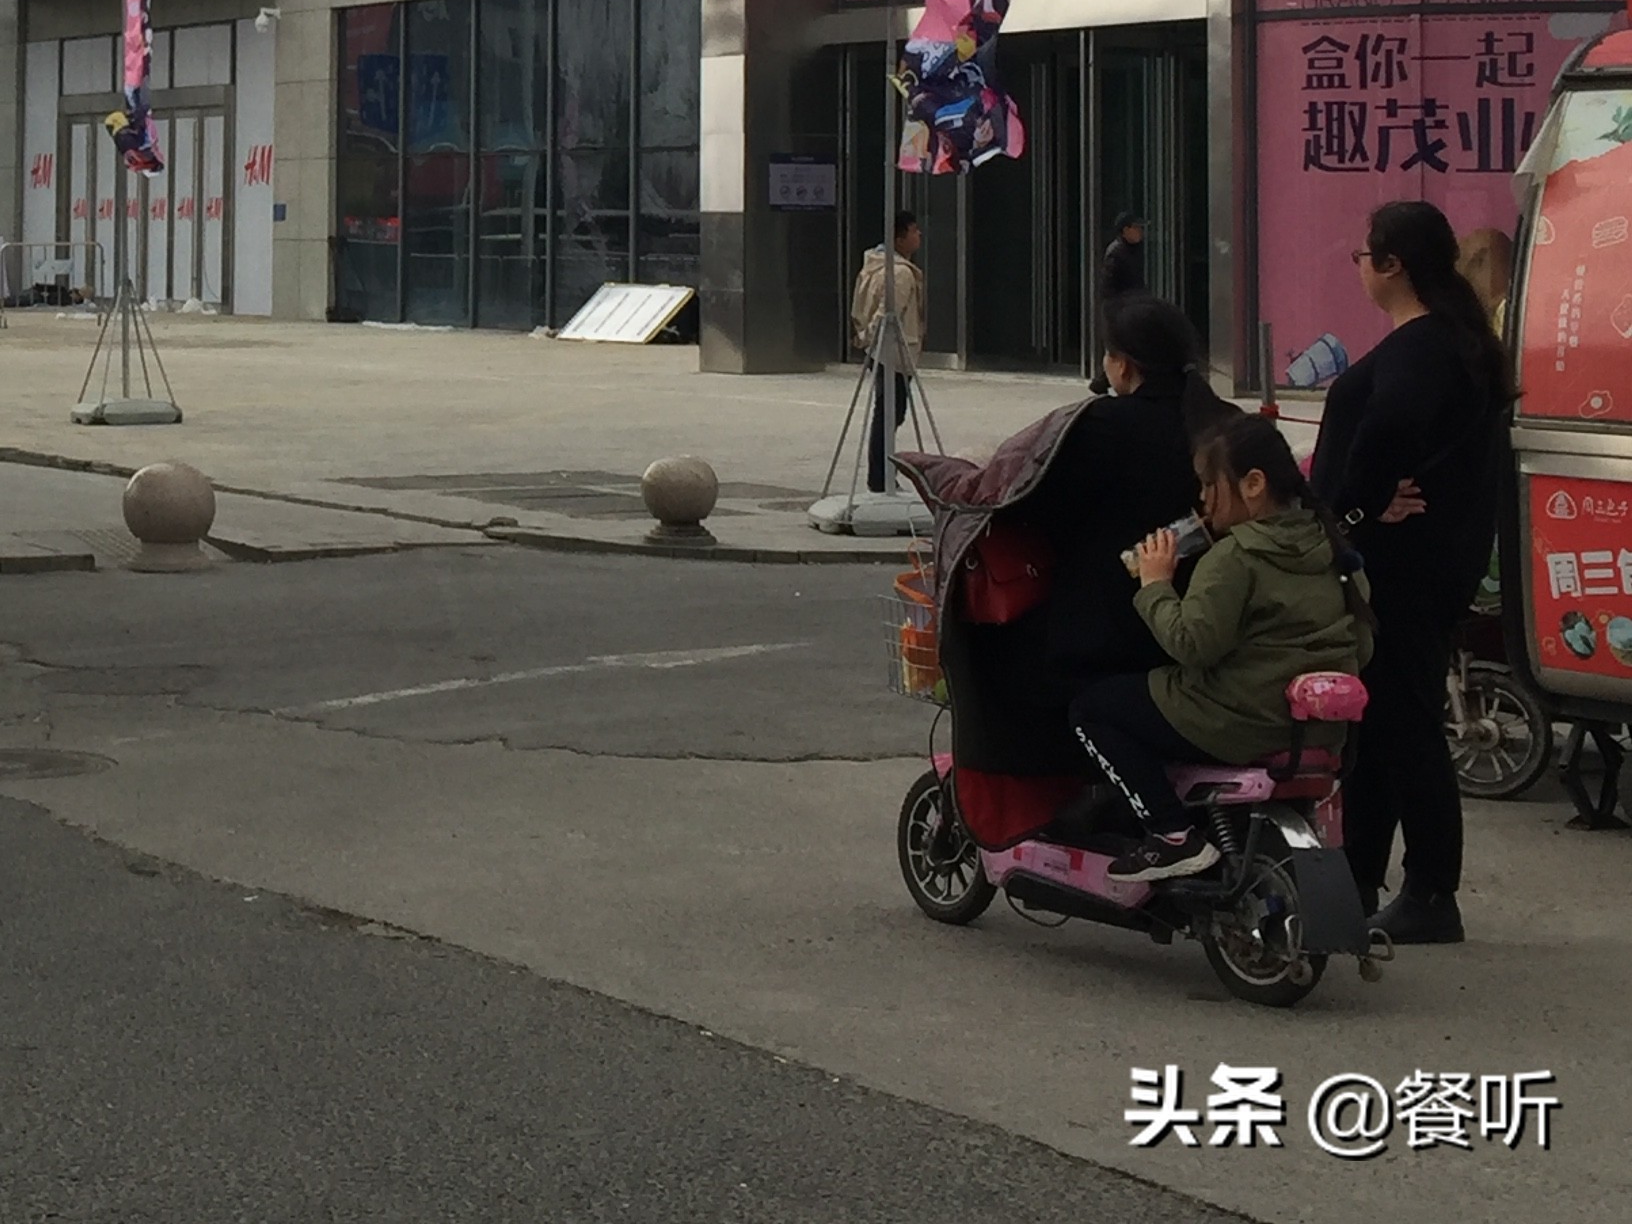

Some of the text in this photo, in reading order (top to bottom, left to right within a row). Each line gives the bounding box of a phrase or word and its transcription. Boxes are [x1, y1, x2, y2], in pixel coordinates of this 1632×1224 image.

[1301, 31, 1537, 90] 盒你一起
[1301, 97, 1536, 173] 趣茂业
